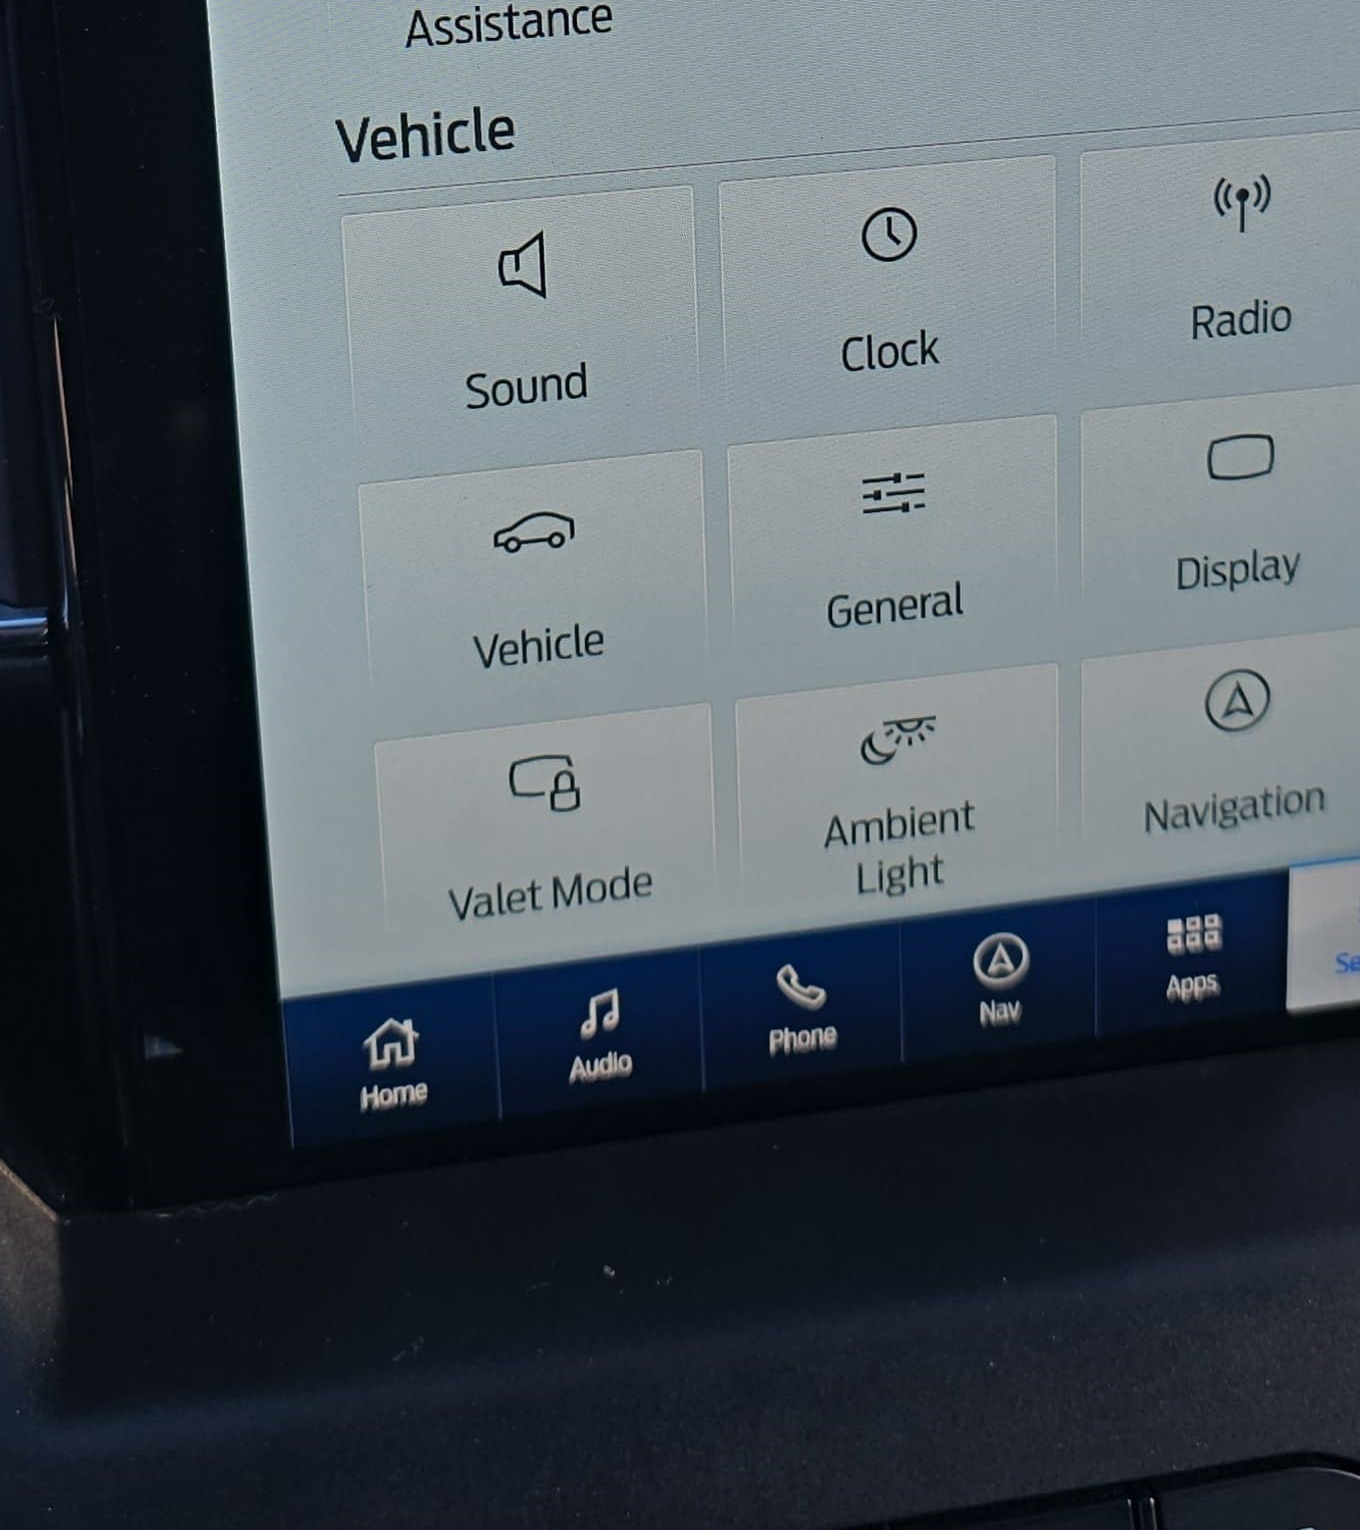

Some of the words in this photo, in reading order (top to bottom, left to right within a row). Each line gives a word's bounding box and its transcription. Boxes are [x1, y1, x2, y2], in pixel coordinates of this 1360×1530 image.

[404, 2, 614, 50] Assistance
[333, 103, 516, 165] Vehicle
[1191, 296, 1294, 341] Radio
[840, 326, 941, 374] Clock
[464, 359, 589, 411] Sound
[1176, 547, 1302, 593] Display
[826, 578, 965, 630] General
[471, 621, 606, 670] Vehicle
[822, 799, 976, 850] Ambient
[1143, 785, 1327, 835] Navigation
[447, 878, 543, 923] Valet
[551, 864, 654, 910] Mode
[856, 853, 945, 899] Light
[1165, 971, 1221, 1002] Apps
[978, 998, 1022, 1025] Nav
[767, 1024, 839, 1055] Phone
[568, 1049, 634, 1083] Audio
[359, 1080, 430, 1111] Home
